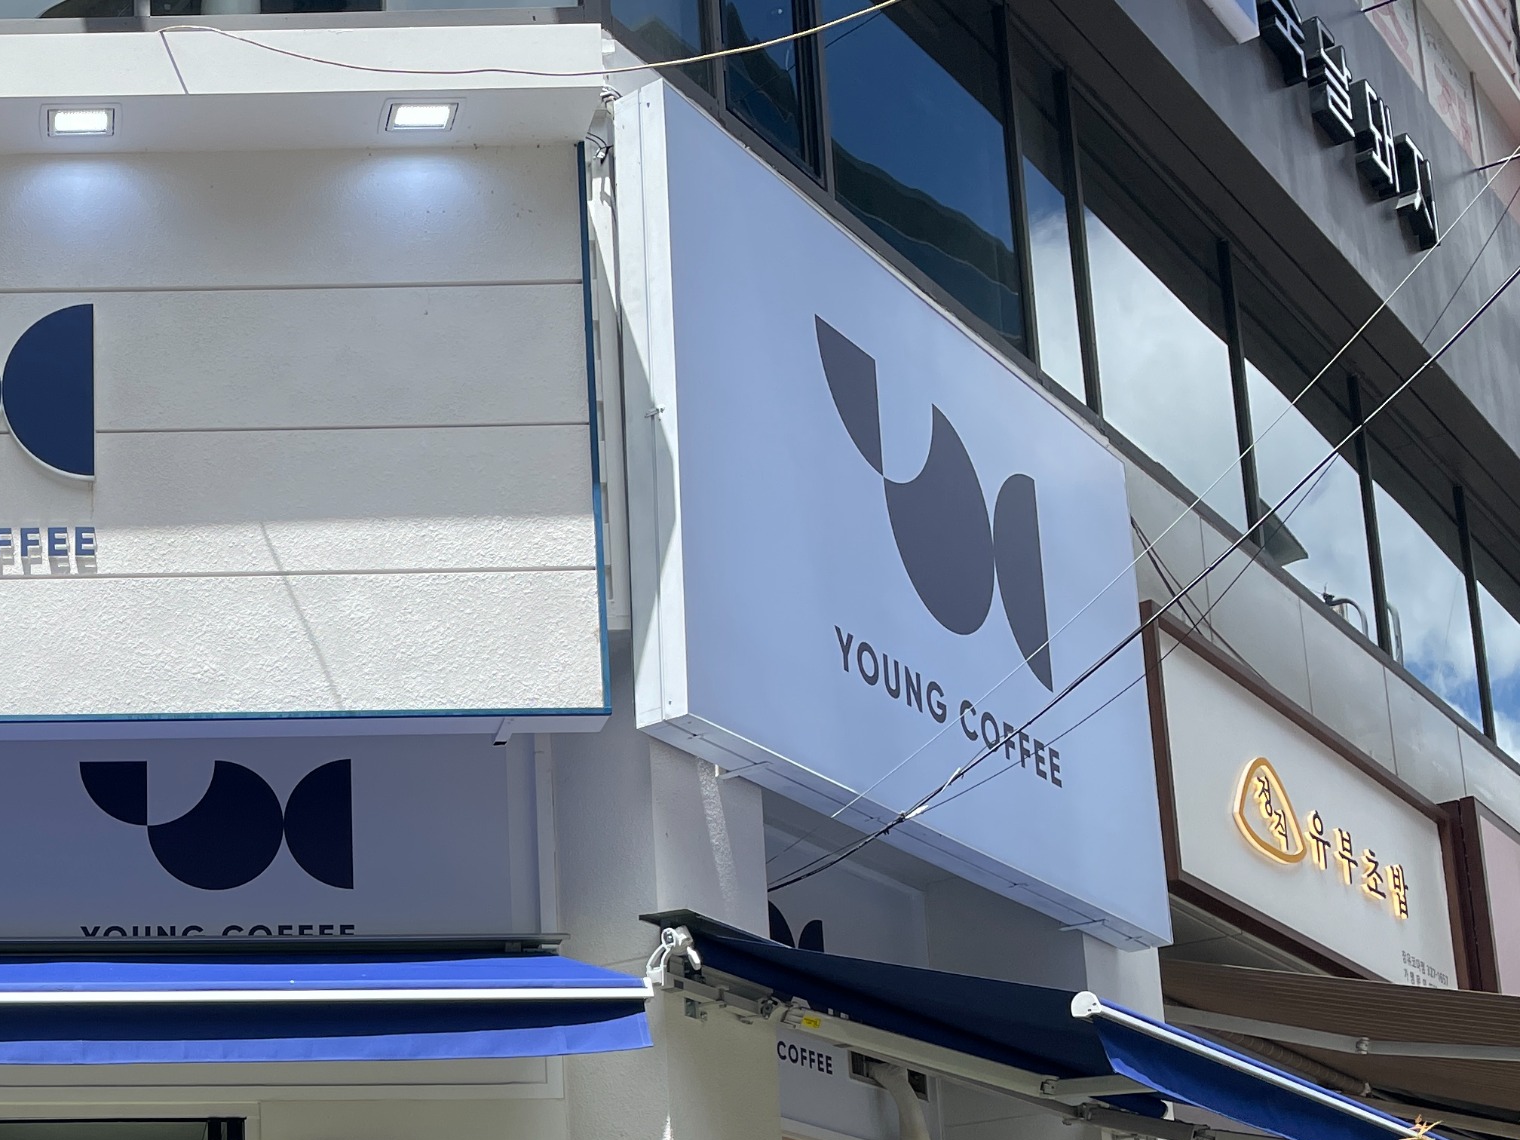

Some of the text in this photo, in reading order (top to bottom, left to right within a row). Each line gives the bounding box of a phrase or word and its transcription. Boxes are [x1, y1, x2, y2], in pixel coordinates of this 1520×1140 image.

[834, 625, 1063, 788] YOUNG COFFEE
[1253, 776, 1289, 851] 정직
[1305, 810, 1409, 919] 유부초밥
[777, 1041, 833, 1075] COFFEE
